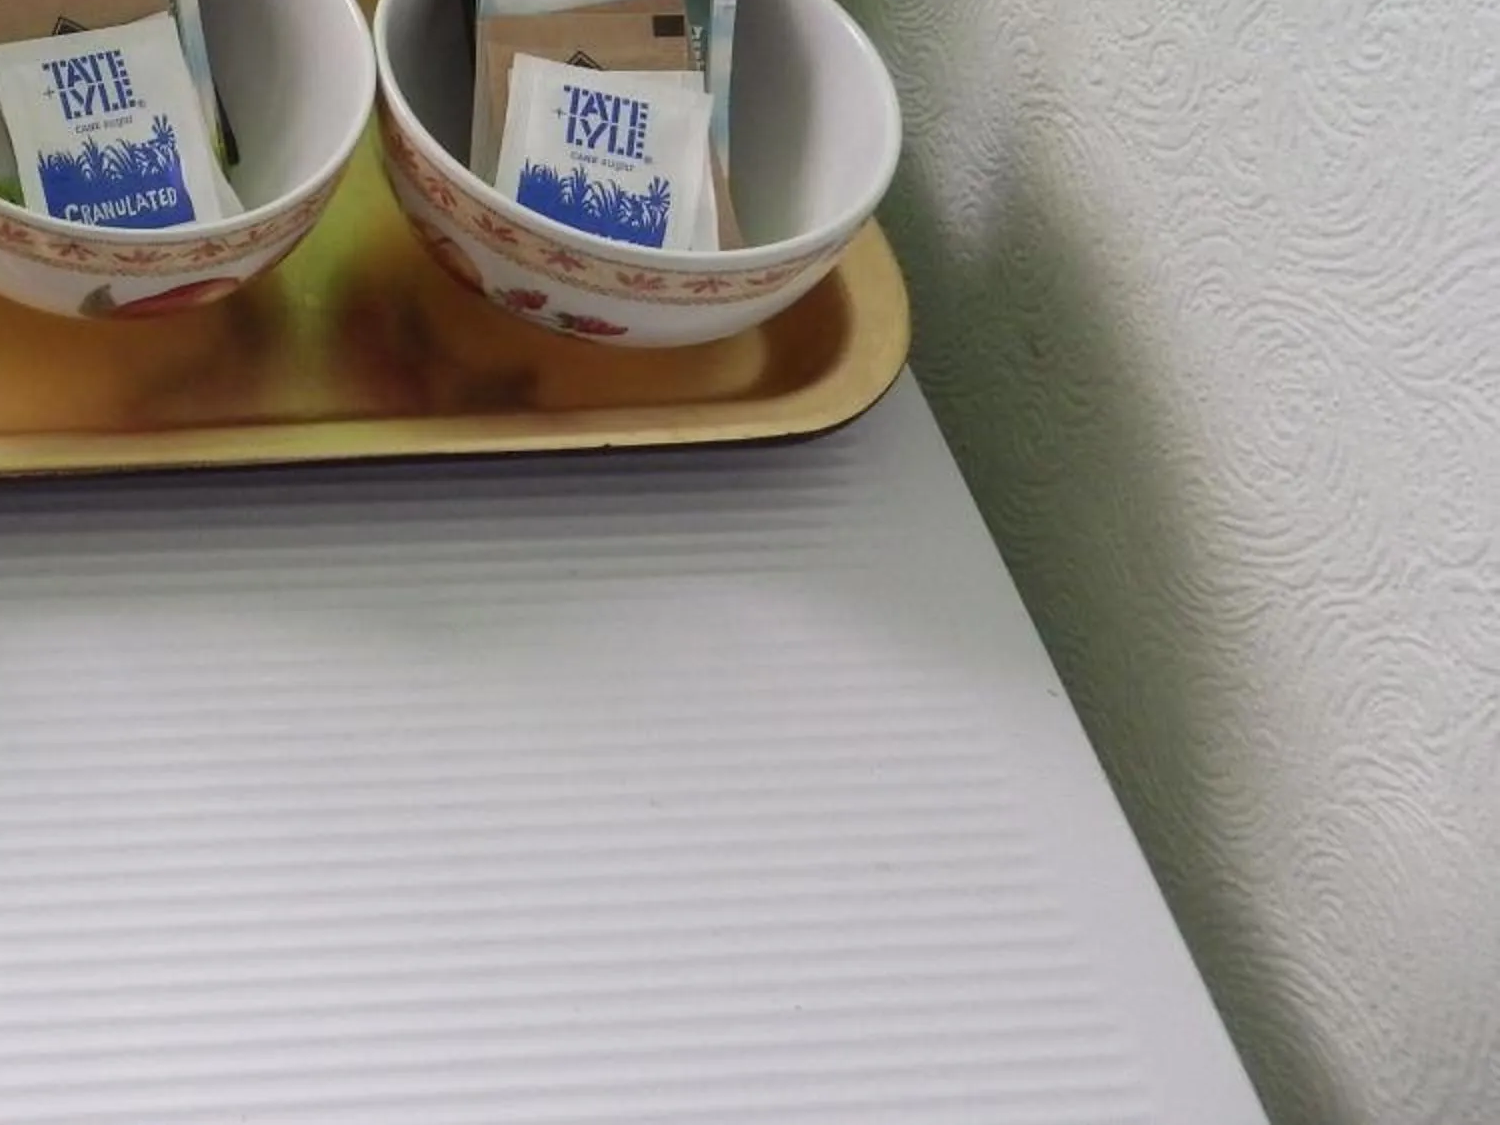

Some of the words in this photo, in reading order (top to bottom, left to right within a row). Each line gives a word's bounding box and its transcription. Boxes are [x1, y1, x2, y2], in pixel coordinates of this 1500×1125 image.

[42, 49, 128, 89] TATE
[58, 79, 137, 121] LYLE
[563, 85, 649, 128] TATE
[566, 116, 646, 160] LYLE
[64, 186, 178, 225] GRANULATED
